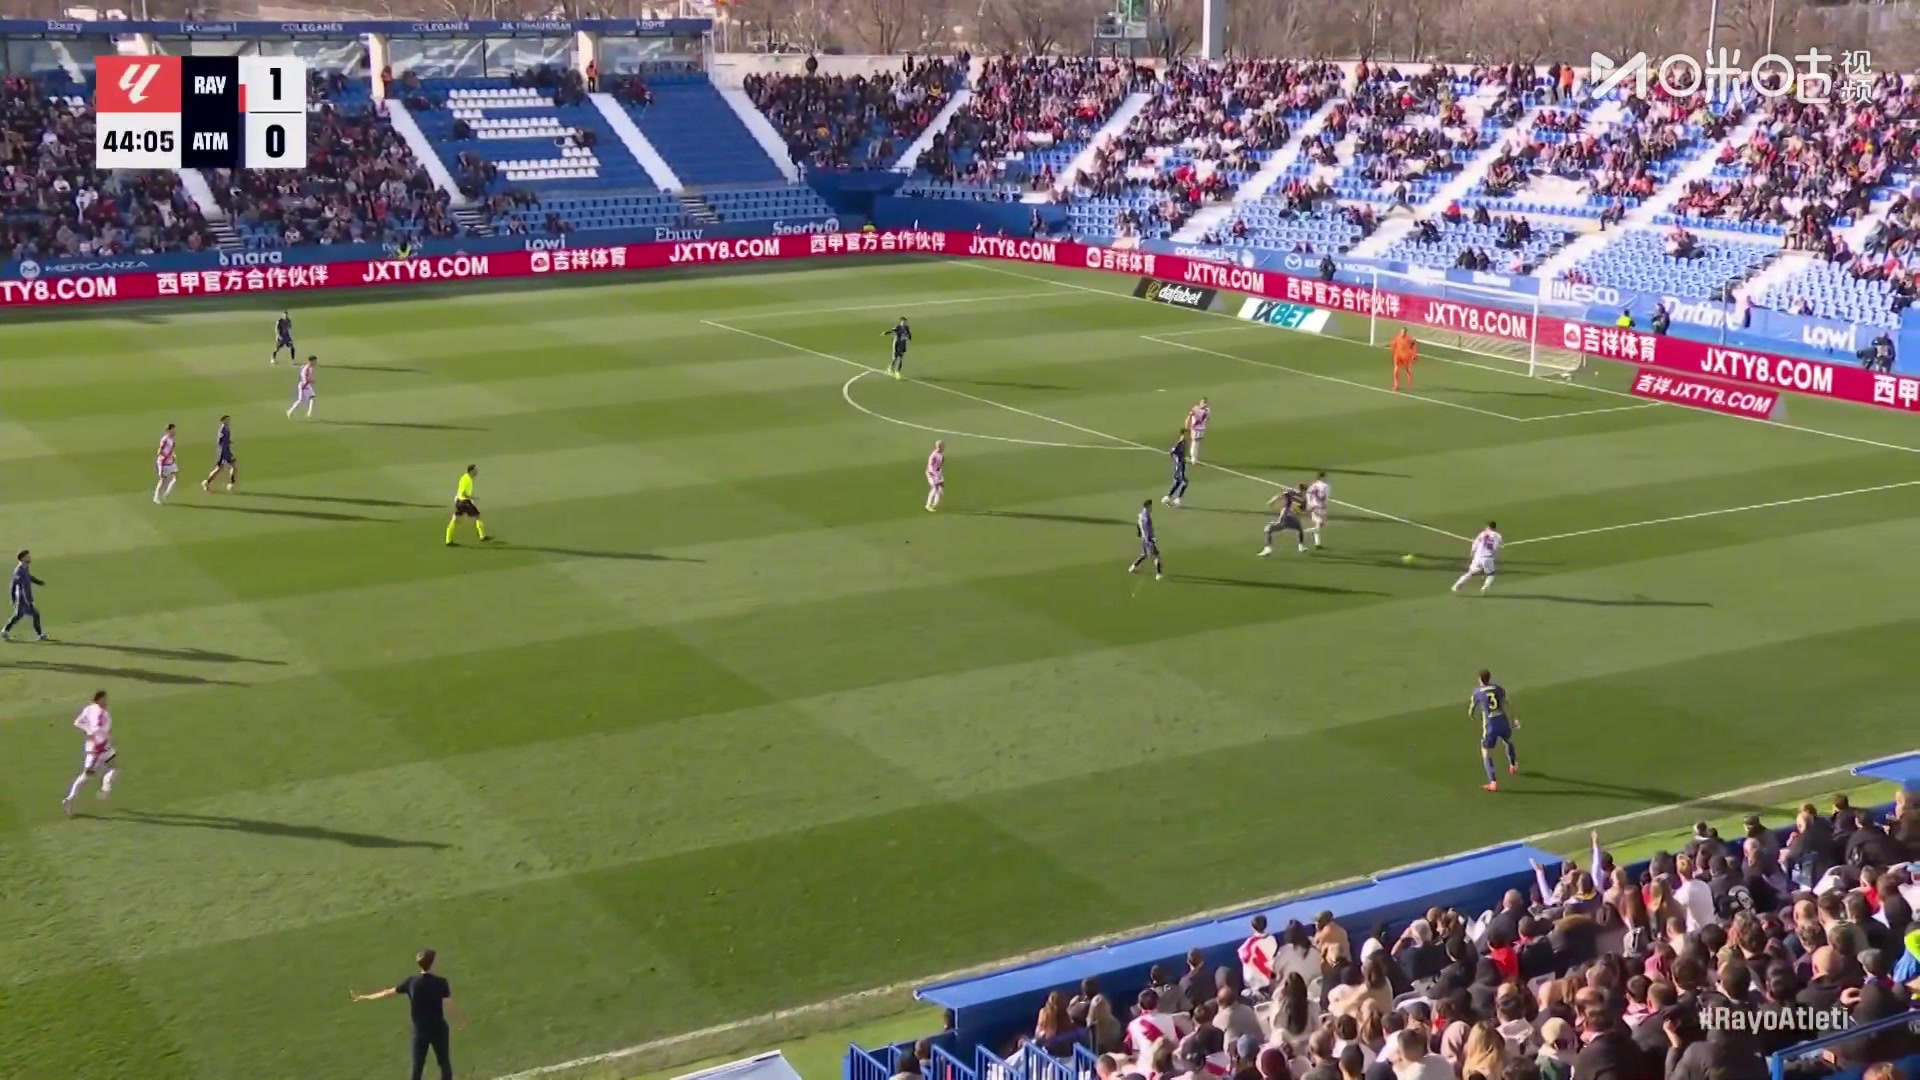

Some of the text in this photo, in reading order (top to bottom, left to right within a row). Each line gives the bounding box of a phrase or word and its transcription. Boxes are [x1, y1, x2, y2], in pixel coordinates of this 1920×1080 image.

[669, 238, 780, 263] JXTY8.COM
[810, 231, 946, 253] 西甲官方合作伙伴
[969, 236, 1056, 262] JXTY8.COM
[45, 260, 150, 273] MERCANZA
[362, 256, 489, 283] JXTY8.COM
[551, 246, 627, 271] 吉祥体育
[1102, 250, 1156, 275] 吉祥体育
[156, 265, 329, 295] 西甲官方合作伙伴
[1184, 261, 1264, 293] JXTY8.COM
[1424, 301, 1527, 339] JXTY8.COM
[1583, 326, 1657, 363] 吉祥体育
[1700, 347, 1834, 394] JXTY8.COM
[1635, 373, 1773, 414] 吉祥 JXTY8.COM
[1486, 691, 1499, 710] 3
